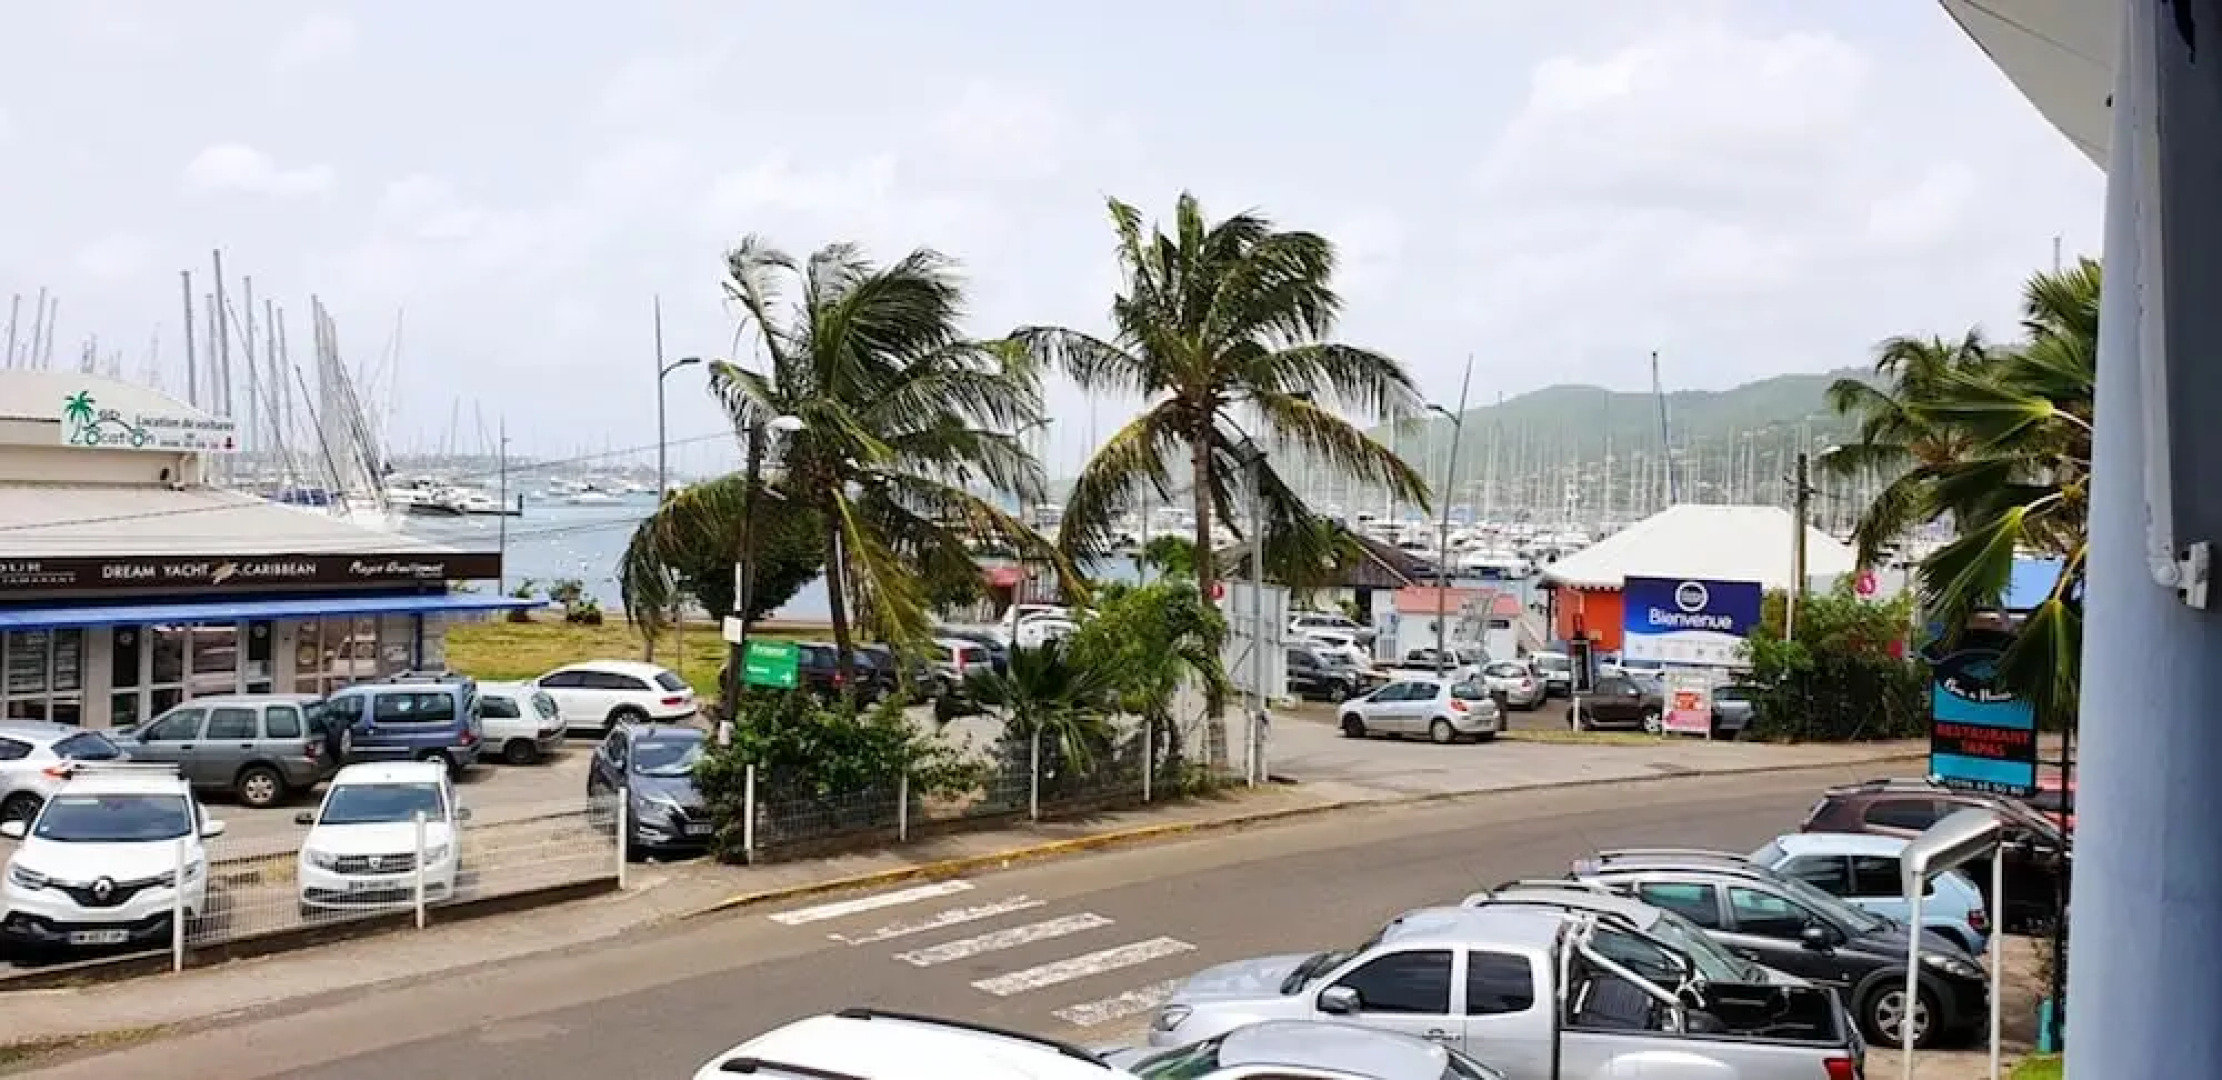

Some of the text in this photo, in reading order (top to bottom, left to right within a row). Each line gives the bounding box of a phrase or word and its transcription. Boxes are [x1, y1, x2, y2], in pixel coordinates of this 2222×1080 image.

[102, 562, 316, 579] DREAM YACHT CARIBBEAN
[1648, 608, 1732, 630] Bienvenue
[1936, 722, 2028, 745] RESTAURANT
